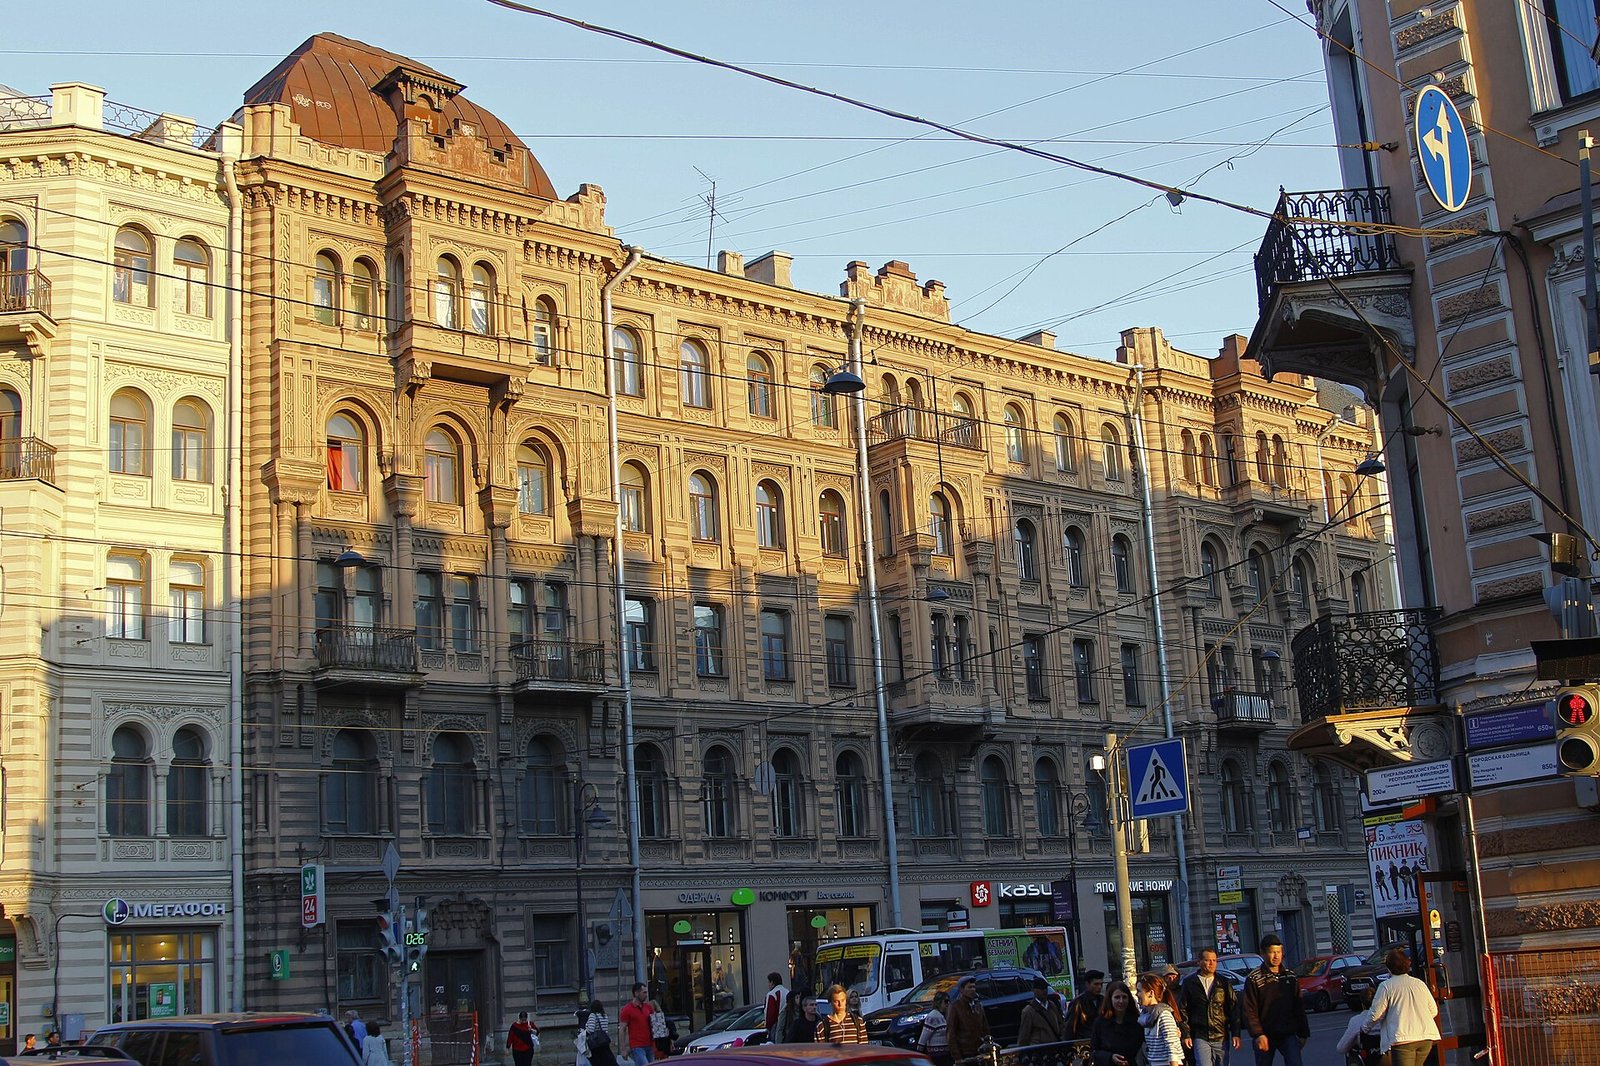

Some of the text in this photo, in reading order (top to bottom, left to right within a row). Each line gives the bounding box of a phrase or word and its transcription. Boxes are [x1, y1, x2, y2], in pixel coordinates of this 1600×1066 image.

[1471, 754, 1502, 763] ГОРОДСКАЯ
[1381, 764, 1449, 778] ГЕНЕРАЛЬНОЕ КОНСУЛЬСТВО
[1378, 830, 1385, 842] 5
[1370, 842, 1426, 862] ПИКНИК
[1145, 880, 1173, 892] НОЖИ
[678, 892, 721, 904] ОДЕЖДА
[760, 890, 808, 901] КОМФОРТ
[132, 903, 225, 918] МЕГАФОН
[305, 898, 315, 914] 24
